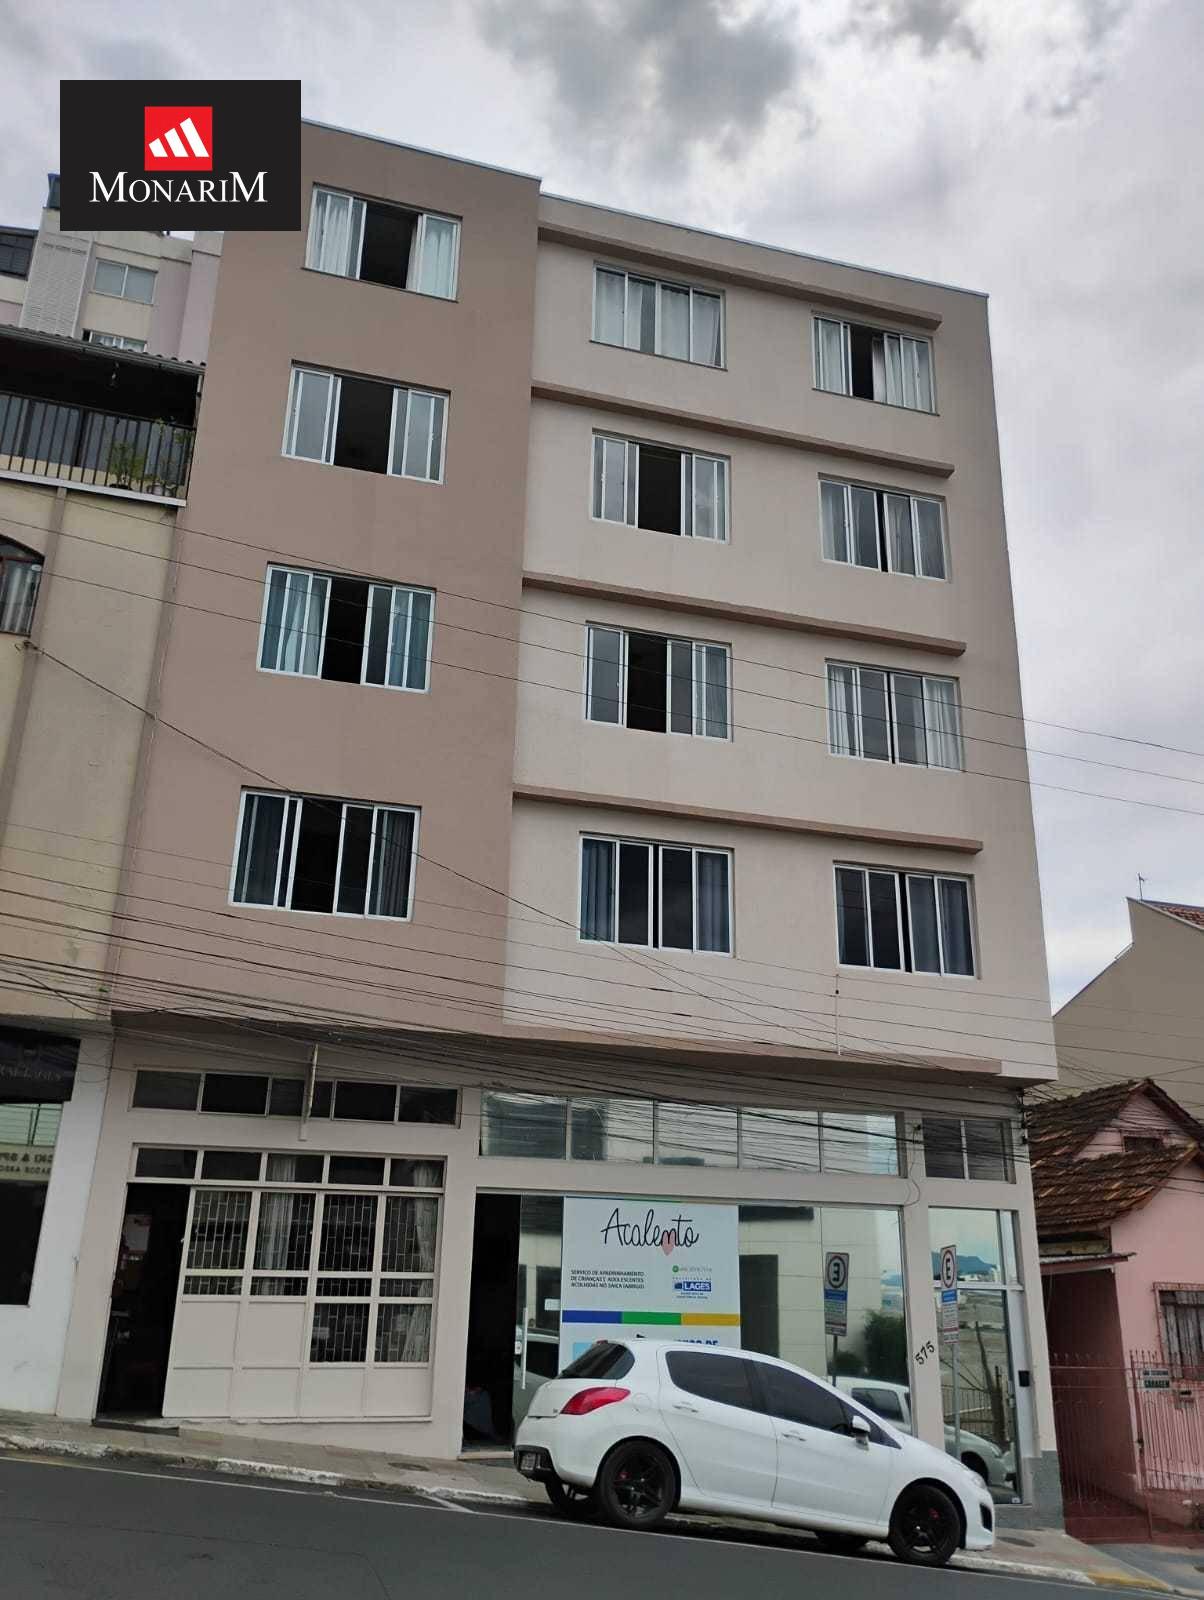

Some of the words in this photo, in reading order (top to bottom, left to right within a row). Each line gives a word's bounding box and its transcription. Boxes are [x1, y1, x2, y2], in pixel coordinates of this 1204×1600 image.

[600, 1207, 700, 1248] Acalento
[684, 1282, 710, 1290] LAGES
[914, 1340, 935, 1365] 575
